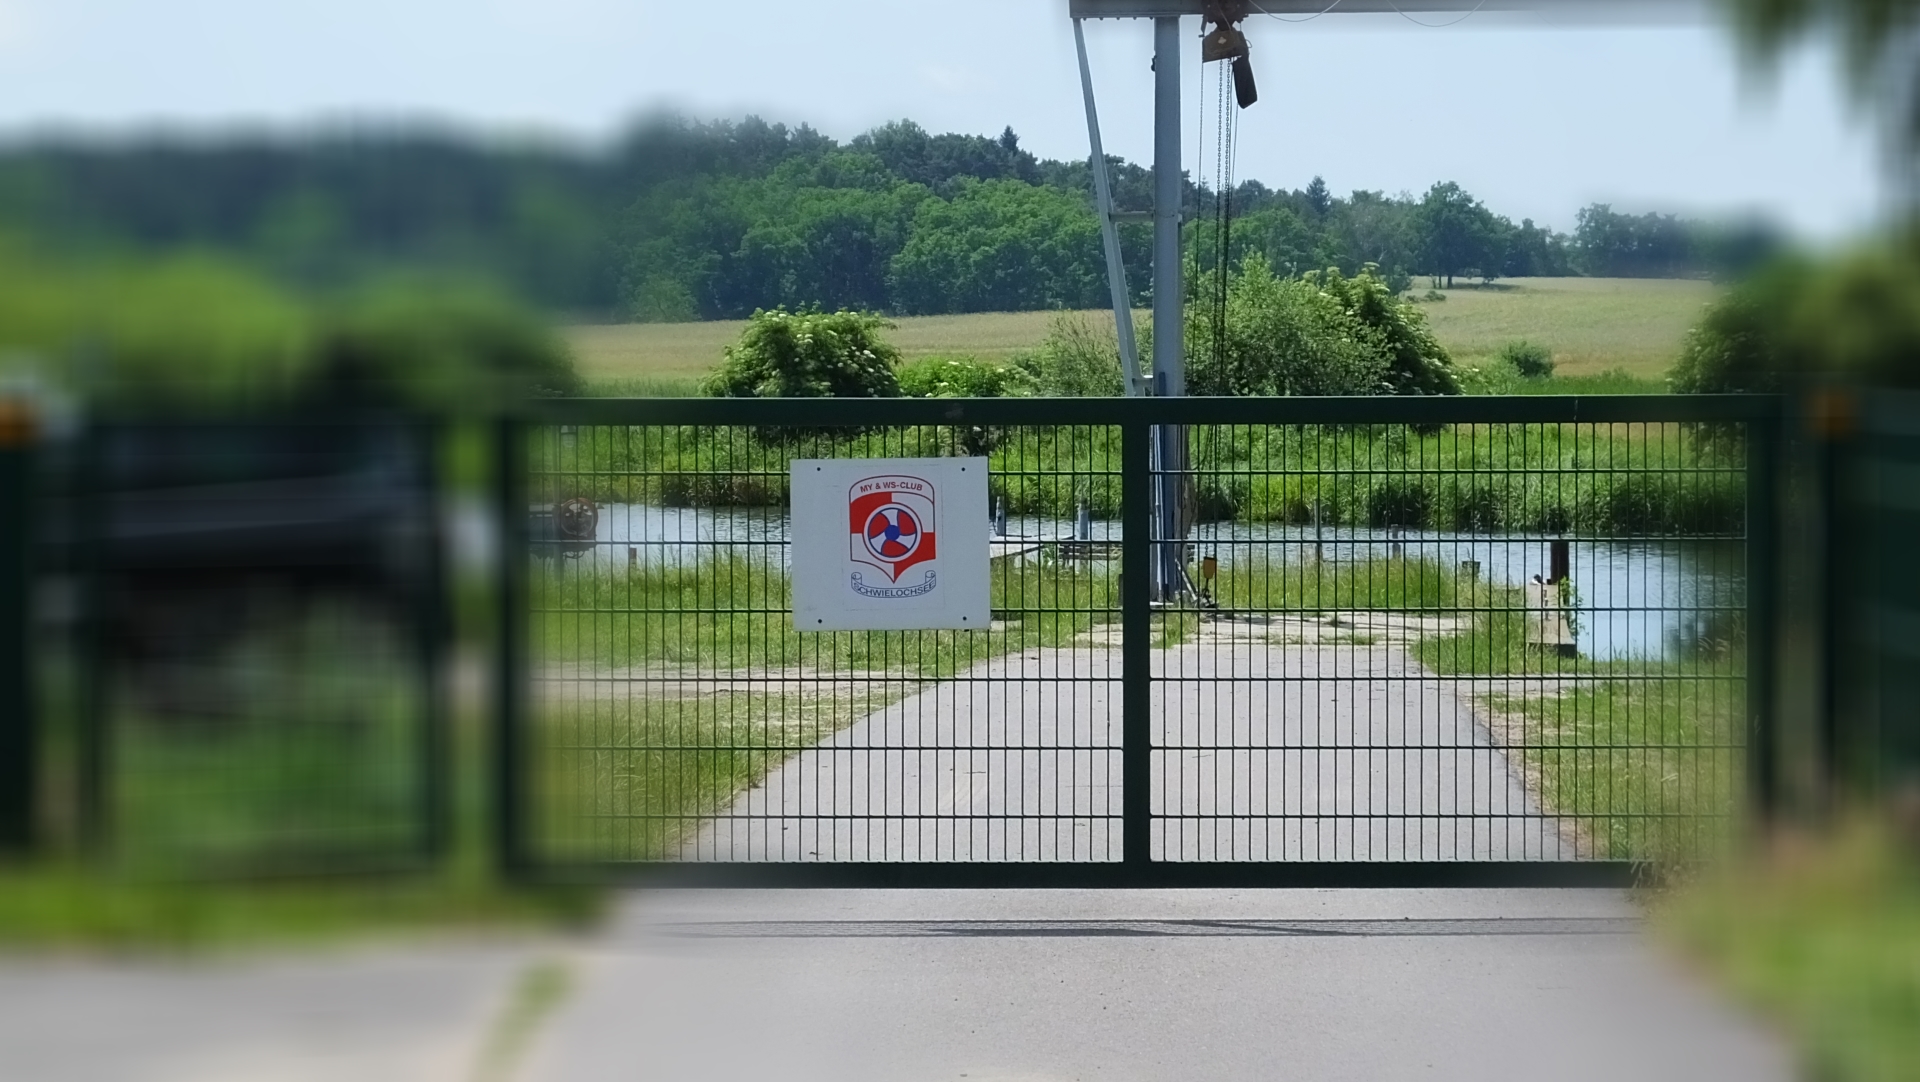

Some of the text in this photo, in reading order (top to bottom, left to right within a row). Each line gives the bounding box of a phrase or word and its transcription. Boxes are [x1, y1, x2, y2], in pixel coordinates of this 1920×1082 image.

[860, 481, 923, 493] MY & WS-CLUB
[853, 581, 935, 597] SCHWIELOCHSEE
